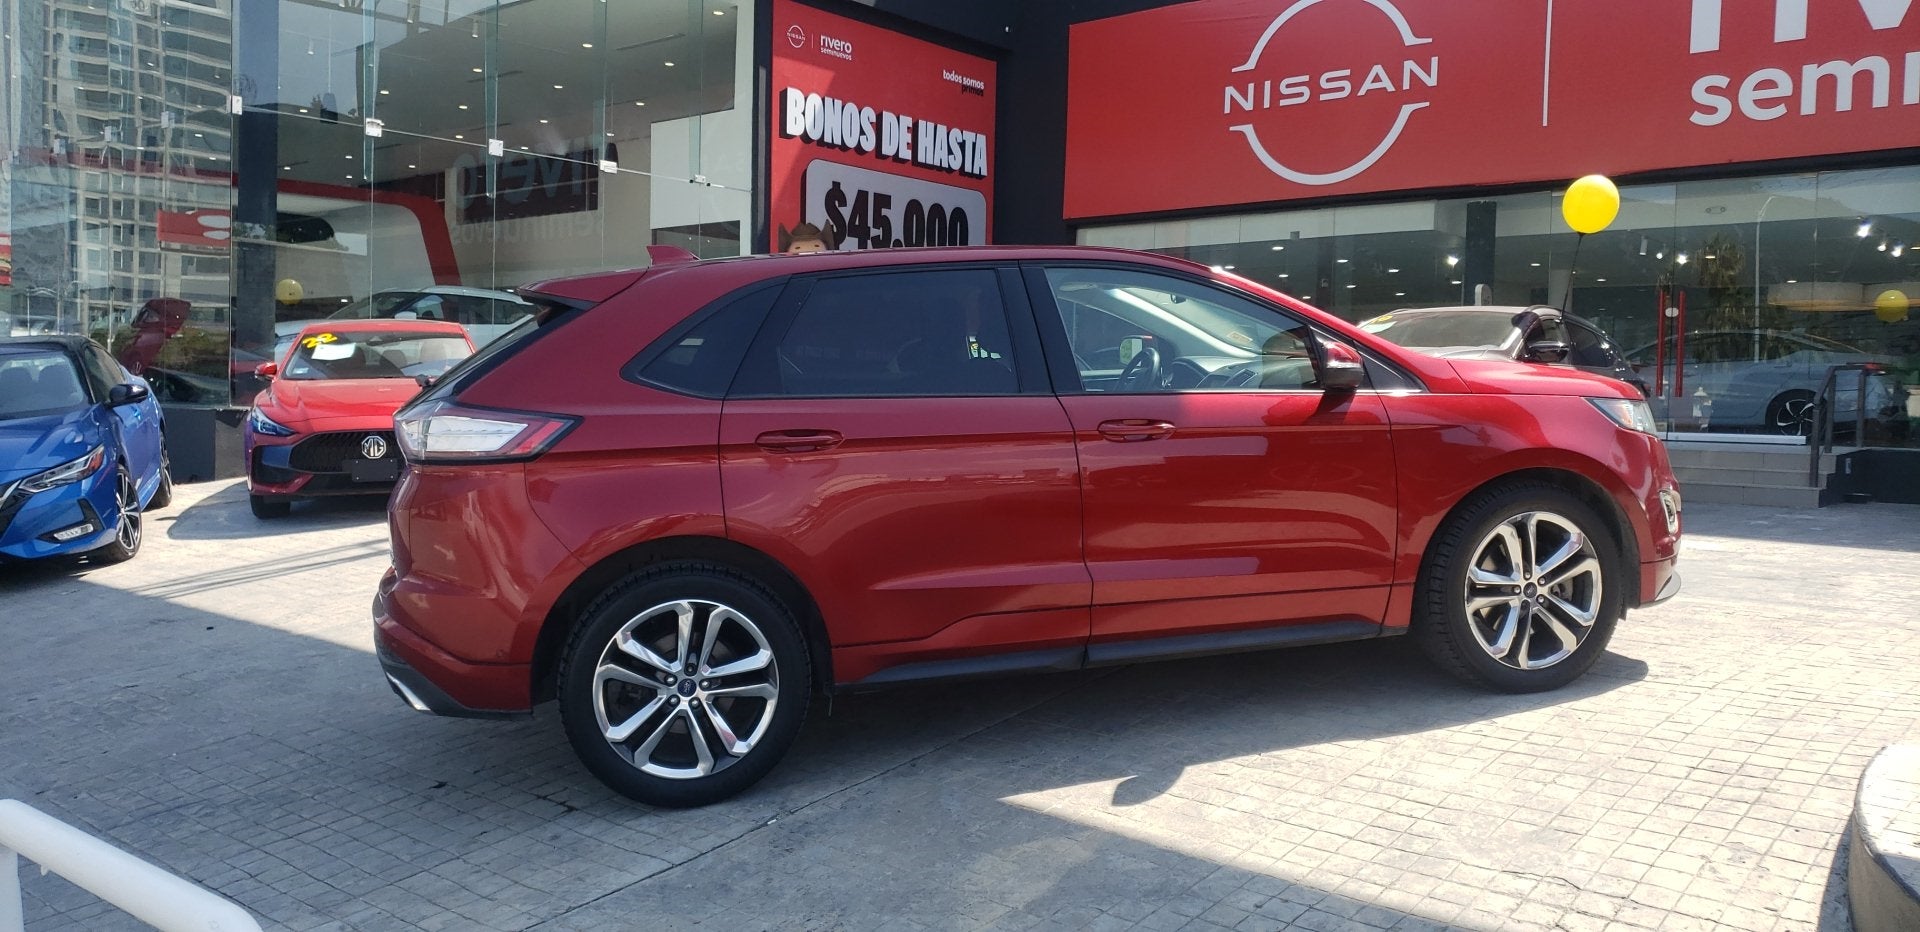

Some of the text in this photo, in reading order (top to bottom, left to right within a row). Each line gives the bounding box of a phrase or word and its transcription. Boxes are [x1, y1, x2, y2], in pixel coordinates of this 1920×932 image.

[820, 34, 852, 54] rivero
[943, 69, 984, 90] todos somos
[1224, 56, 1439, 114] NISSAN
[784, 86, 987, 176] BONOS DE HASTA
[363, 437, 386, 458] MG
